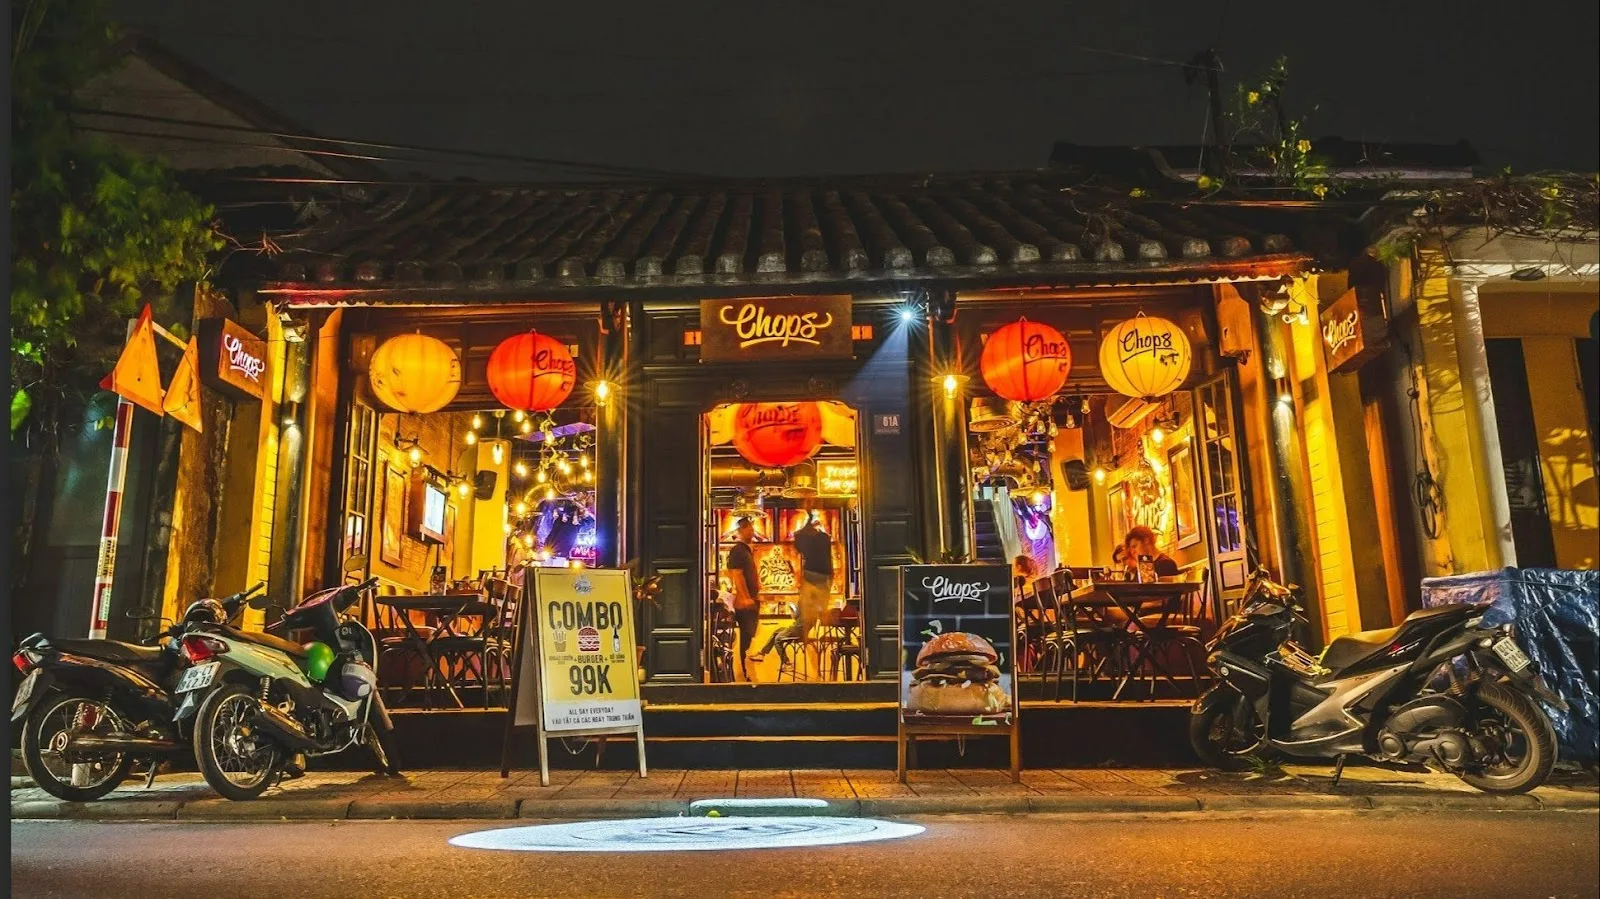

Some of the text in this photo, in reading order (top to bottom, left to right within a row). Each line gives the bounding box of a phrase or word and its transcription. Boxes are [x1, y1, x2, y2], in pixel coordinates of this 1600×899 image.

[720, 303, 832, 347] Chops
[1323, 310, 1358, 350] Chops
[224, 334, 265, 379] Chops
[1120, 327, 1173, 358] Chops
[883, 416, 898, 427] 61A
[760, 568, 795, 590] Chops
[922, 576, 990, 603] Chops
[548, 600, 623, 631] COMBO
[577, 654, 604, 664] BURGER
[569, 664, 613, 695] 99K
[590, 706, 614, 714] EVERYDAY
